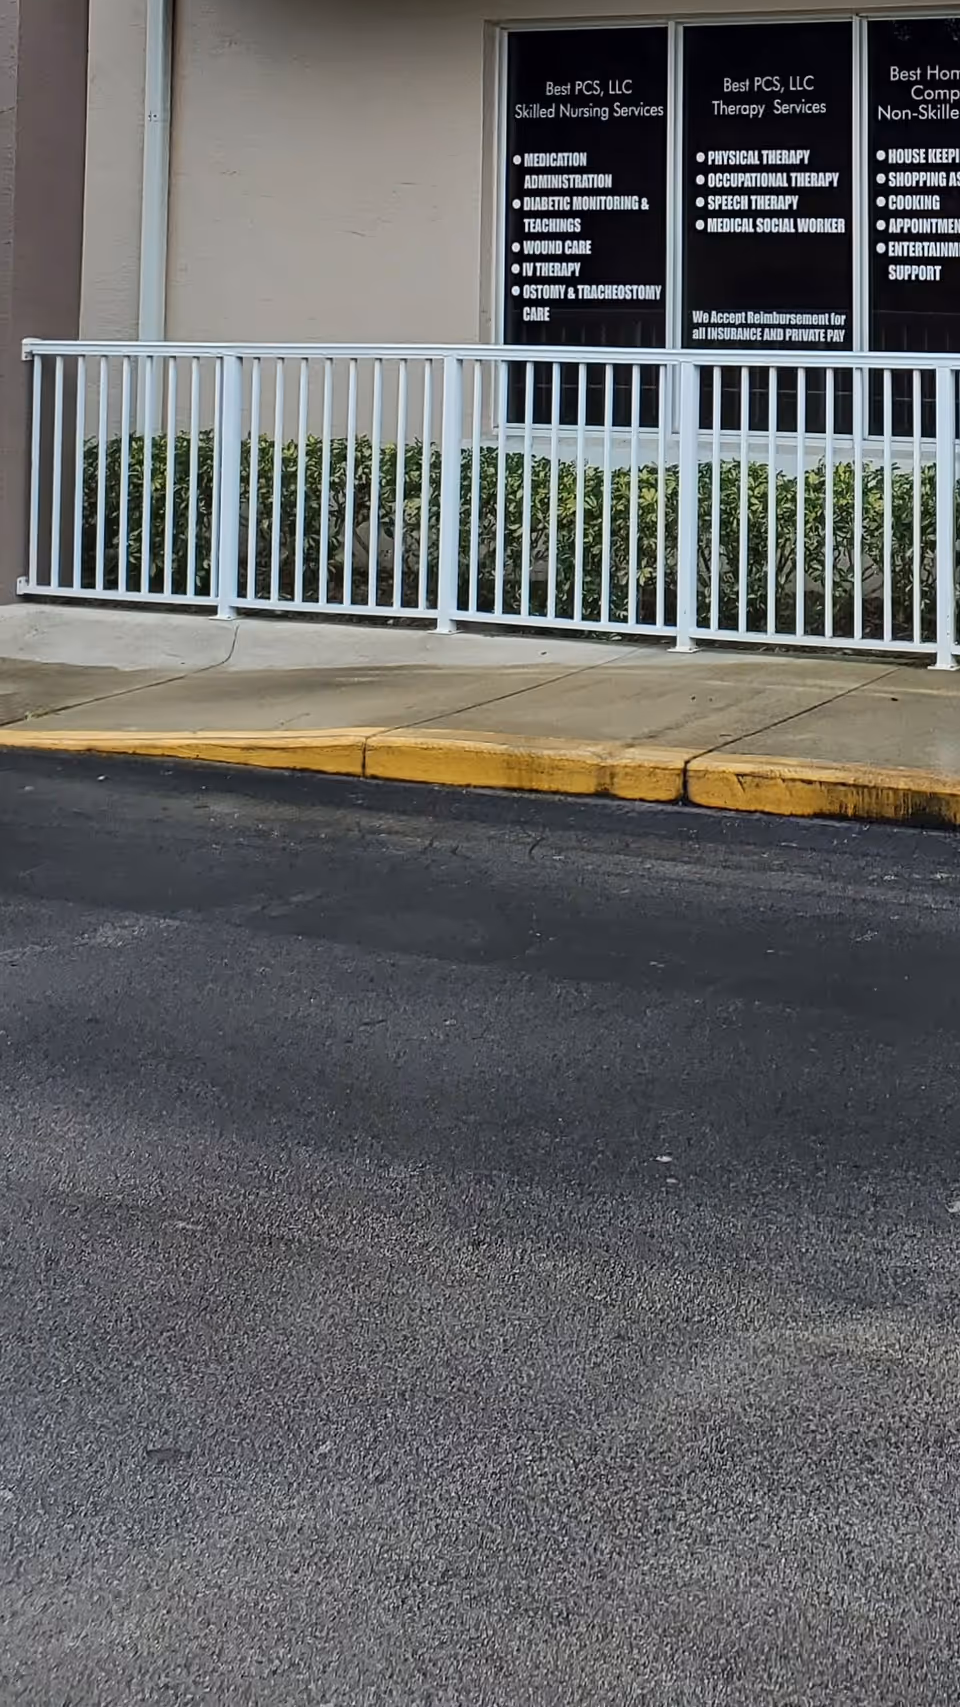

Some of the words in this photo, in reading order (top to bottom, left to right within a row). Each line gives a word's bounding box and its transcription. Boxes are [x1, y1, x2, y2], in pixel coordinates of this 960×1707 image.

[890, 66, 921, 81] Best
[546, 81, 571, 96] Best
[575, 80, 604, 97] PCS,
[609, 79, 633, 94] LLC
[723, 78, 750, 92] Best
[754, 76, 784, 93] PCS,
[789, 76, 814, 90] LLC
[514, 103, 555, 119] Skilled
[560, 103, 609, 121] Nursing
[613, 102, 664, 117] Services
[712, 100, 766, 118] Therapy
[773, 99, 827, 114] Services
[524, 152, 587, 167] MEDICATION
[708, 150, 760, 165] PHYSICAL
[762, 150, 810, 164] THERAPY
[888, 149, 926, 163] HOUSE
[524, 174, 613, 189] ADMINISTRATION
[708, 173, 788, 187] OCCUPATIONAL
[790, 172, 839, 187] THERAPY
[888, 172, 947, 187] SHOPPING
[523, 197, 570, 211] DIABETIC
[572, 196, 639, 210] MONITORING
[641, 198, 649, 210] &
[708, 195, 749, 210] SPEECH
[751, 195, 799, 210] THERAPY
[888, 195, 940, 210] COOKING
[523, 218, 581, 233] TEACHINGS
[707, 218, 754, 232] MEDICAL
[756, 218, 795, 232] SOCIAL
[797, 218, 845, 233] WORKER
[523, 241, 562, 254] WOUND
[564, 240, 592, 254] CARE
[522, 263, 533, 276] IV
[535, 262, 581, 276] THERAPY
[888, 265, 942, 281] SUPPORT
[523, 285, 566, 299] OSTOMY
[568, 287, 575, 299] &
[577, 285, 662, 300] TRACHEOSTOMY
[523, 307, 550, 321] CARE
[692, 311, 709, 323] We
[710, 311, 746, 325] Accept
[748, 311, 829, 325] Reimbursement
[831, 313, 846, 326] for
[692, 327, 705, 339] all
[707, 327, 762, 340] INSURANCE
[764, 328, 784, 340] AND
[785, 329, 825, 341] PRIVATE
[827, 330, 845, 342] PAY
